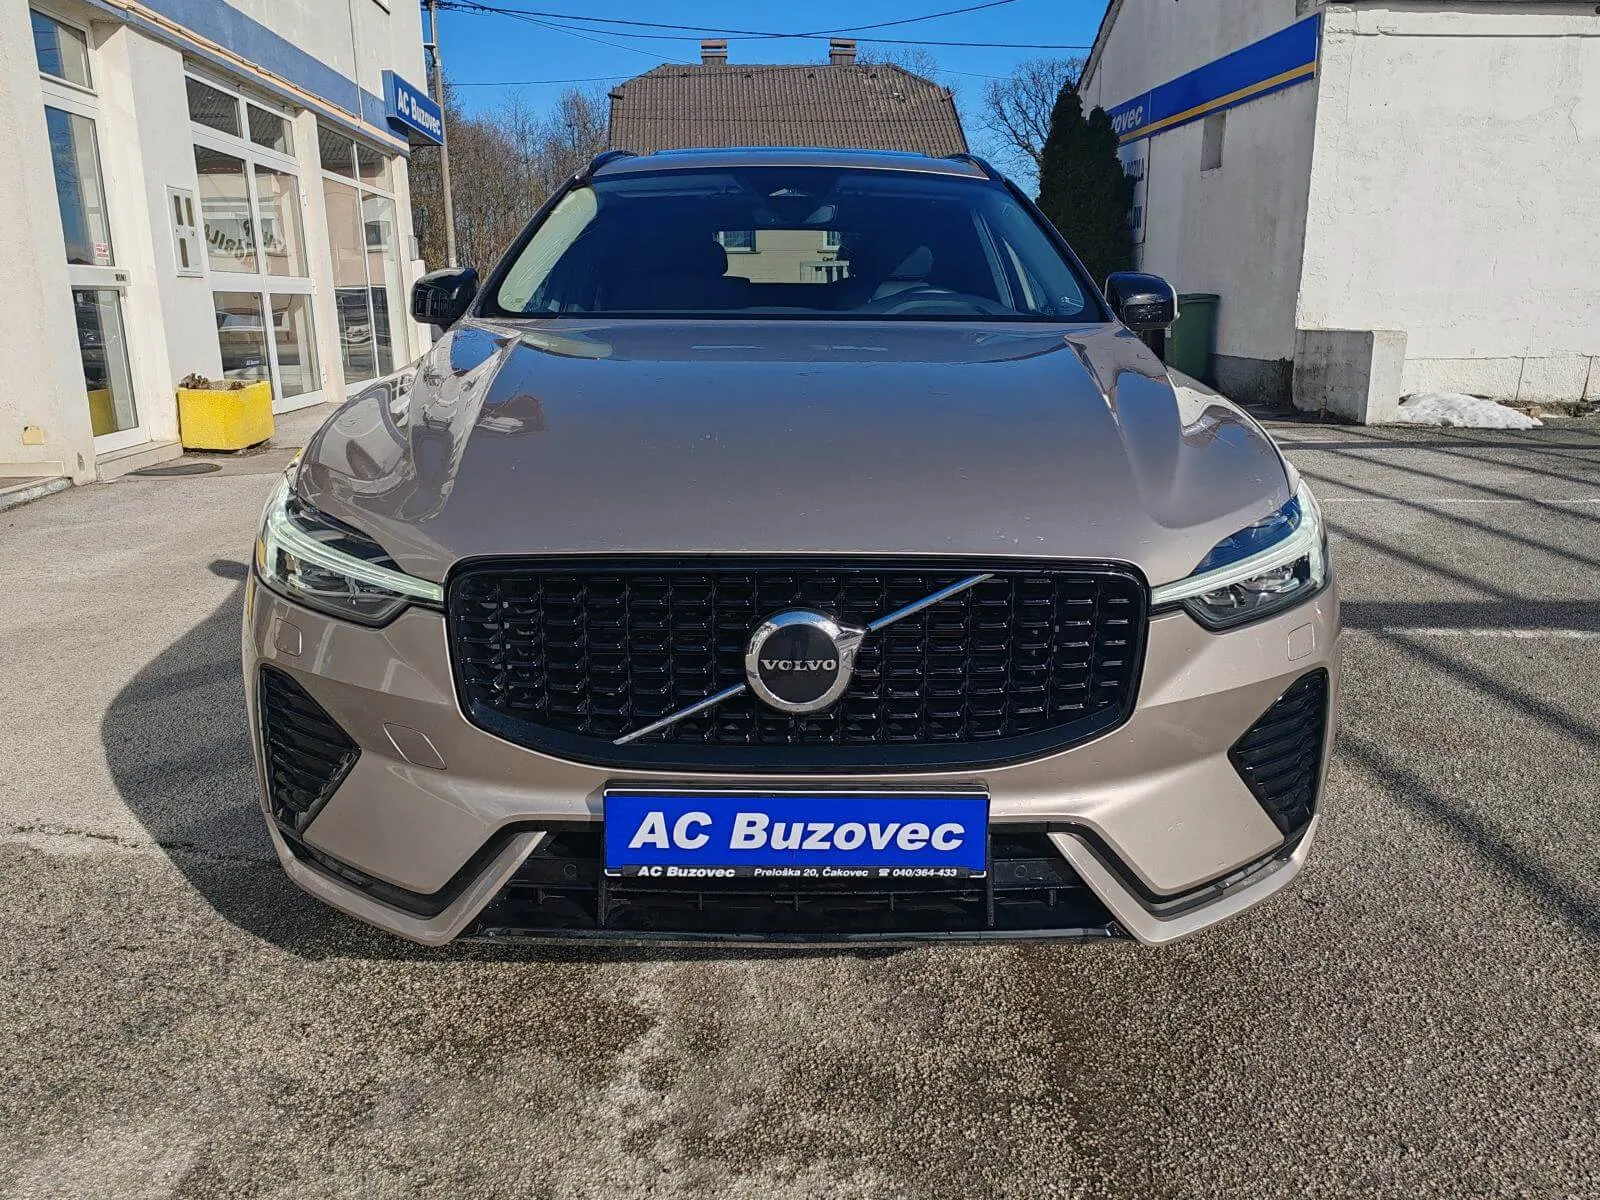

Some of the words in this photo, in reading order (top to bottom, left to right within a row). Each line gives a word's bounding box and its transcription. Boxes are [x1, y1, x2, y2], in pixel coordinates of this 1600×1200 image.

[398, 87, 409, 116] AC
[410, 96, 441, 136] Buzovec
[760, 659, 837, 671] VOLVO
[628, 811, 713, 850] AC
[729, 812, 966, 851] Buzovec
[637, 866, 663, 877] AC
[666, 866, 736, 878] Buzovec
[753, 867, 801, 877] Preloška
[803, 868, 819, 878] 20,
[822, 866, 869, 877] Čakovec
[892, 868, 958, 877] 040/364-433
